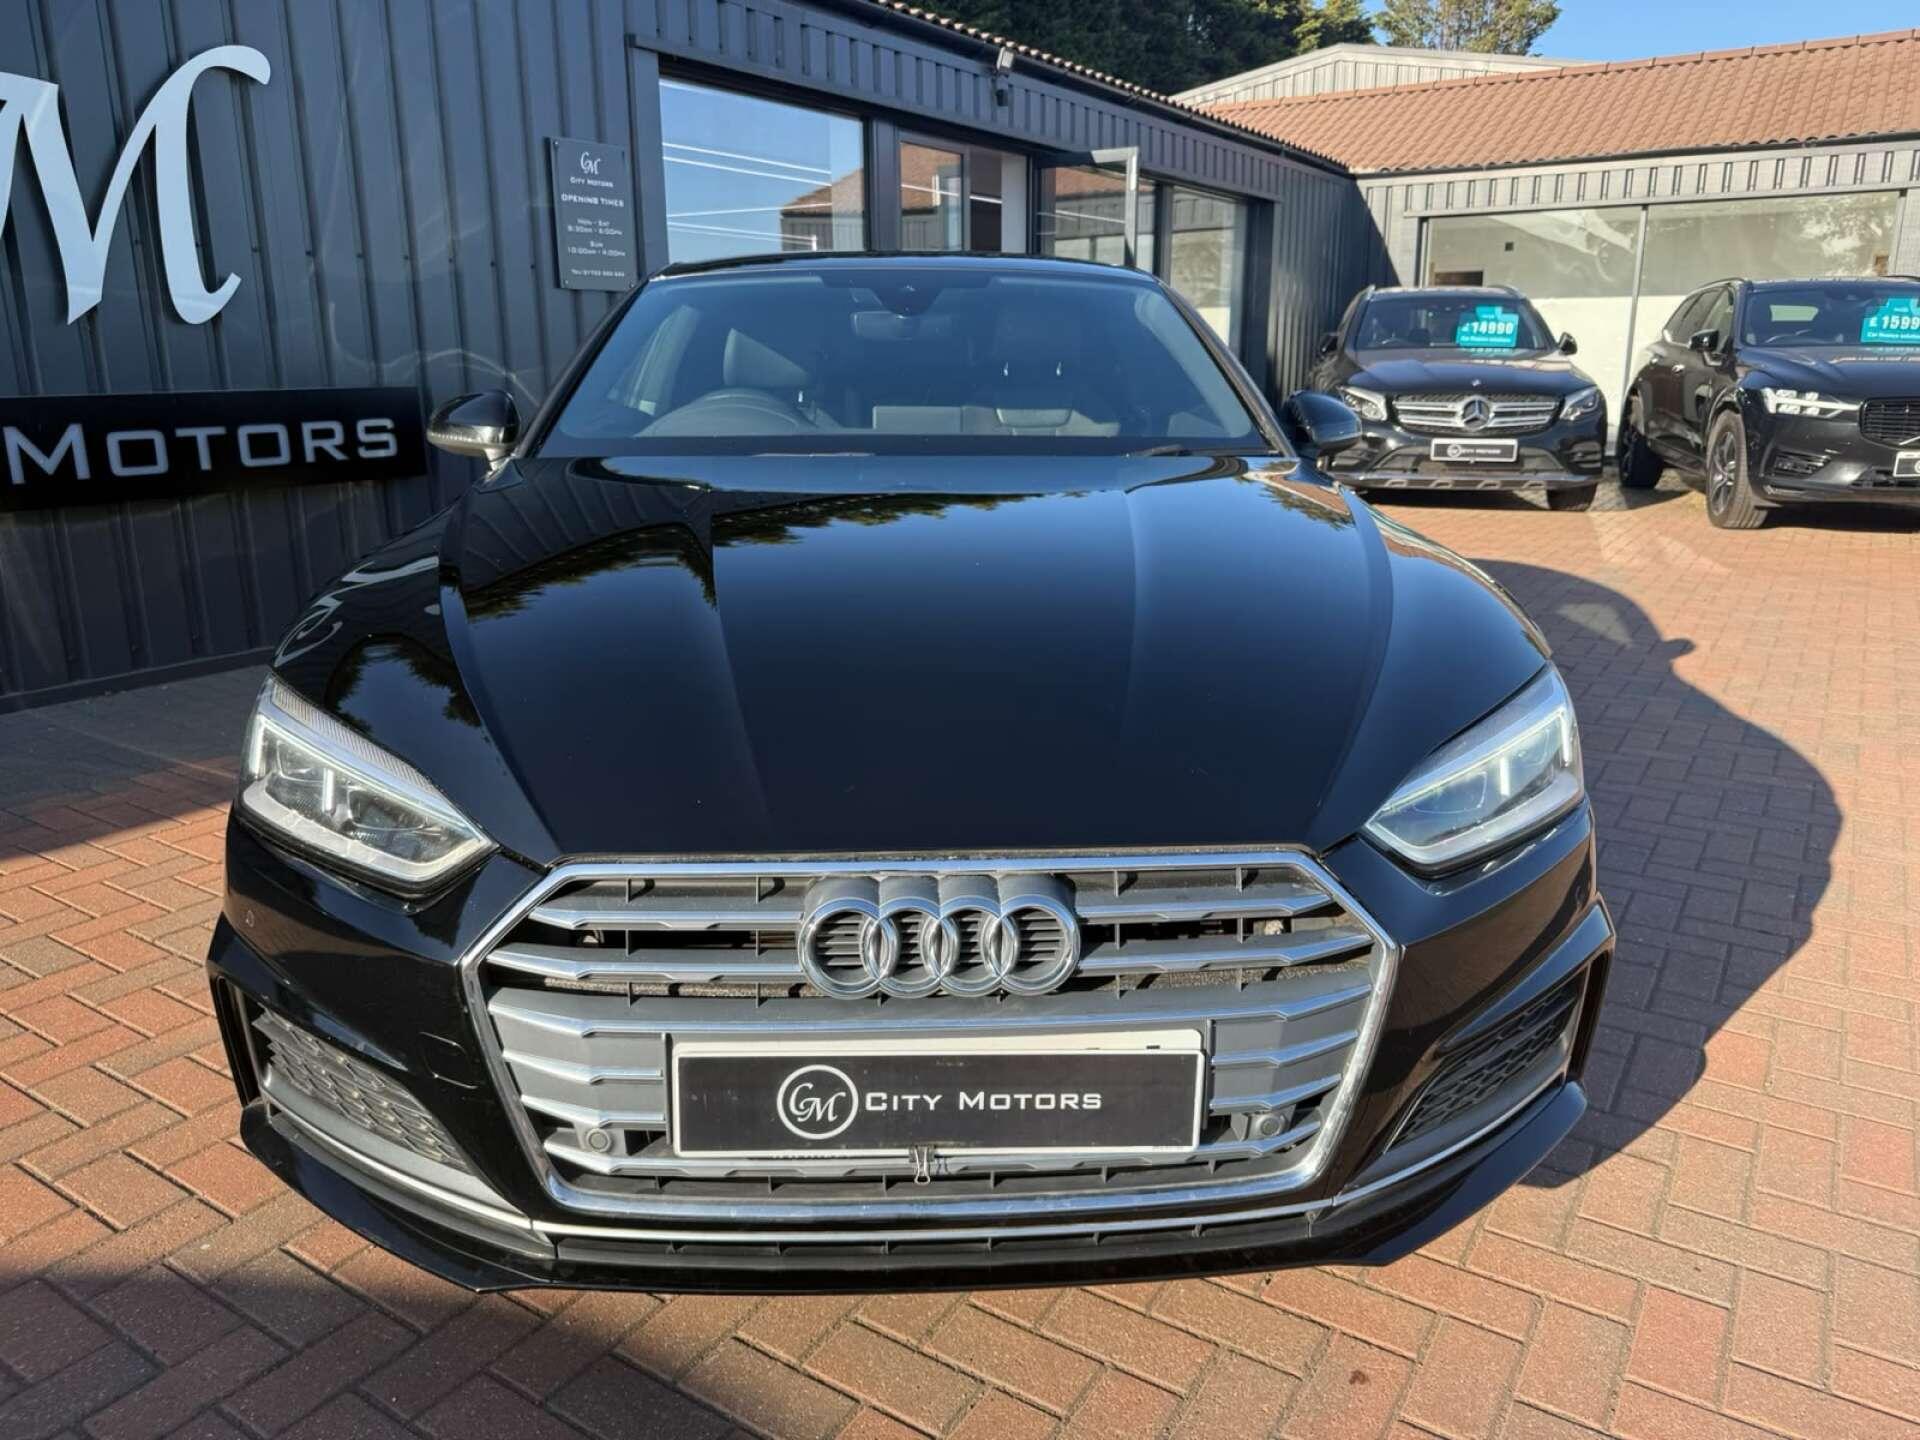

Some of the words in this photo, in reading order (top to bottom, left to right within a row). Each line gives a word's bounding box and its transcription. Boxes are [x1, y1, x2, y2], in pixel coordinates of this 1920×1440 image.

[561, 192, 599, 204] OPENING
[600, 197, 625, 207] TIMES
[2, 418, 398, 485] MOTORS
[865, 1091, 943, 1111] CITY
[959, 1090, 1103, 1111] MOTORS
